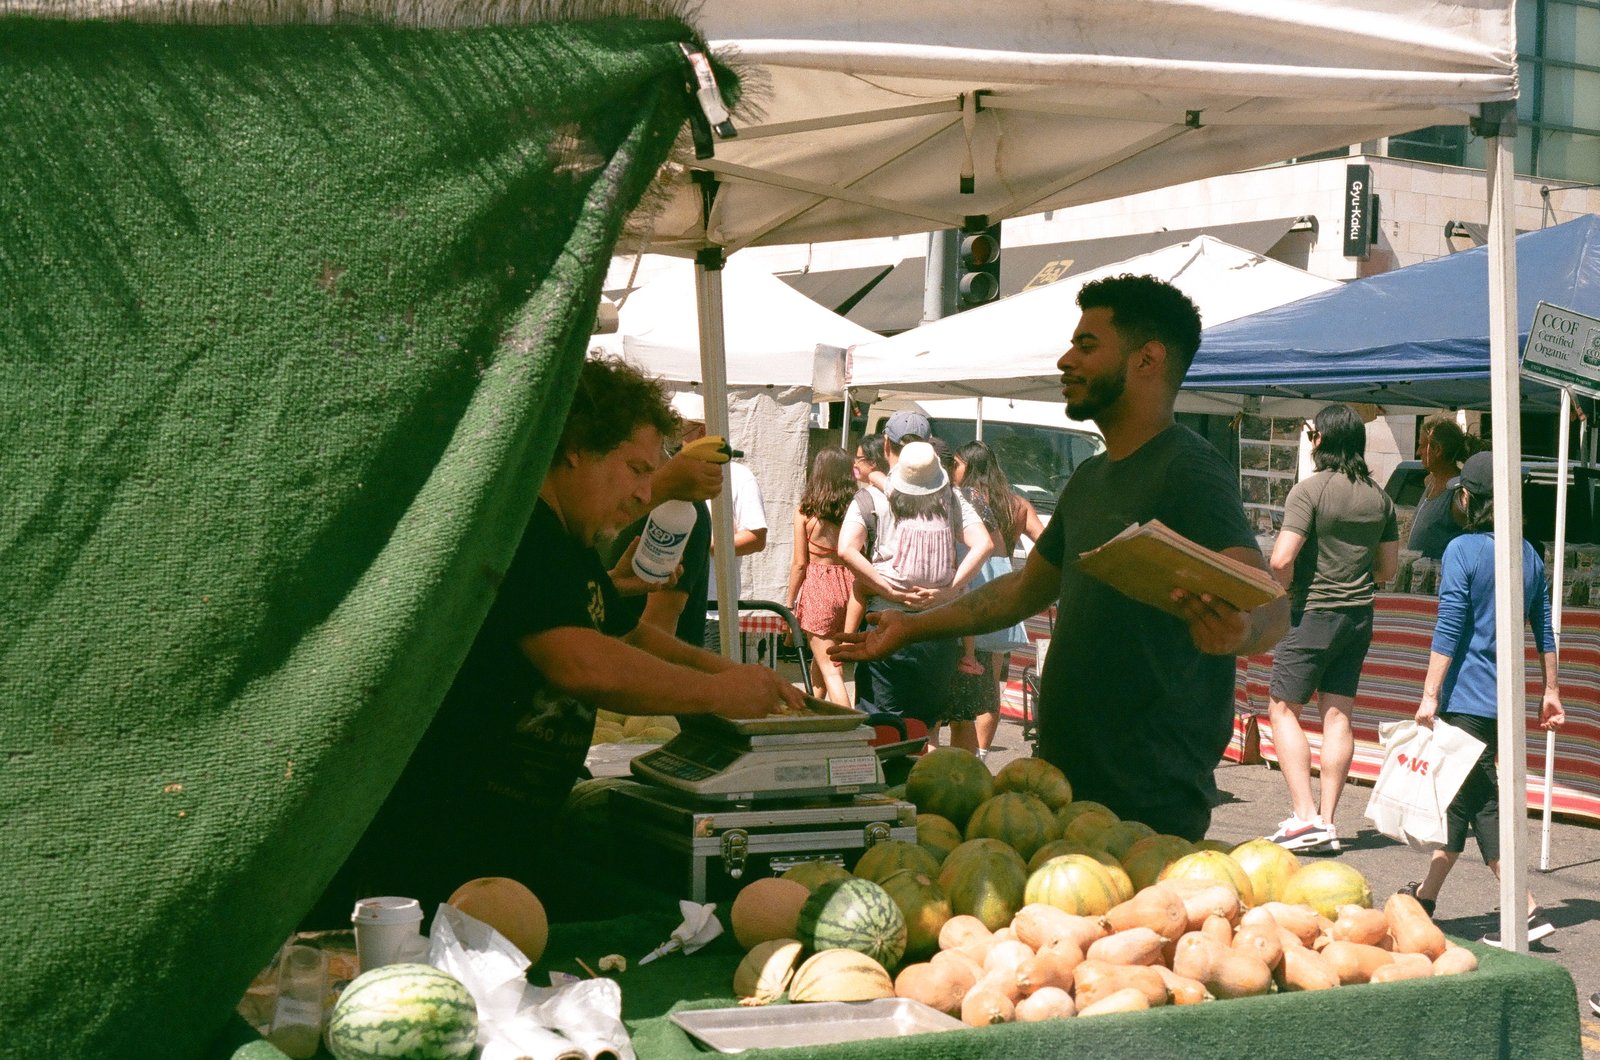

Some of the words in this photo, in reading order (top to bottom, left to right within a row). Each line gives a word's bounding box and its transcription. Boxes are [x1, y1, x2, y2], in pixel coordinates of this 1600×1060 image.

[1350, 180, 1363, 240] Gyu-Kaku
[1542, 313, 1580, 335] CCOF
[1538, 329, 1575, 349] Certified
[1534, 342, 1570, 361] Organic
[1586, 349, 1600, 358] CCO
